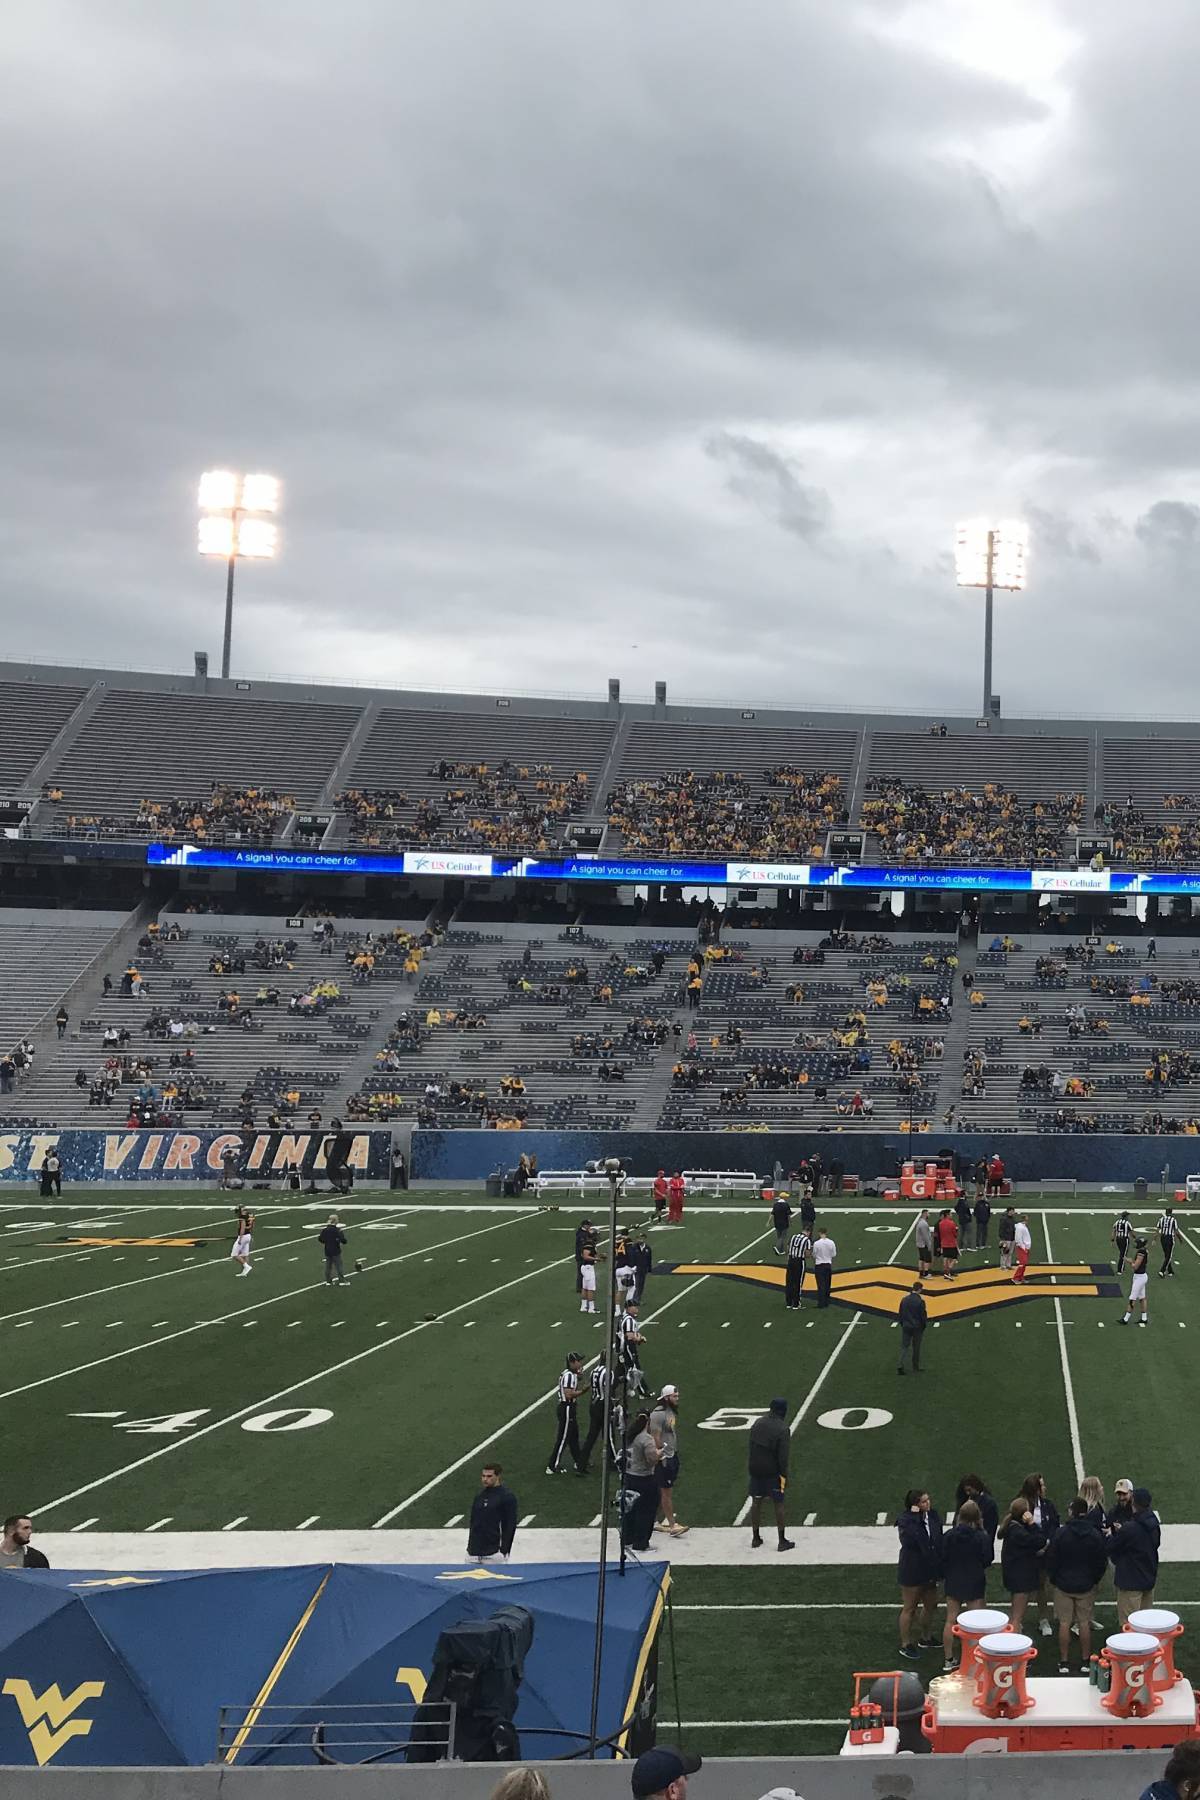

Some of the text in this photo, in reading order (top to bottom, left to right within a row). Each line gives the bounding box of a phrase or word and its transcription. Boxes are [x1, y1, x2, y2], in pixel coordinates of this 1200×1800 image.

[236, 852, 243, 861] A
[245, 853, 274, 864] signal
[276, 855, 294, 864] you
[314, 856, 342, 864] cheer
[447, 862, 482, 871] Cellular
[579, 865, 606, 875] signal
[607, 867, 624, 876] you
[643, 866, 669, 876] cheer
[767, 872, 800, 881] Cellular
[892, 874, 916, 883] signal
[918, 876, 934, 884] you
[952, 875, 977, 884] cheer
[1070, 879, 1102, 888] Cellular
[104, 1134, 370, 1170] VIRGINIA
[912, 1181, 925, 1195] G
[112, 1408, 334, 1432] 40
[697, 1407, 894, 1430] 50
[993, 1666, 1013, 1687] G
[1125, 1665, 1145, 1687] G
[862, 1731, 871, 1741] G
